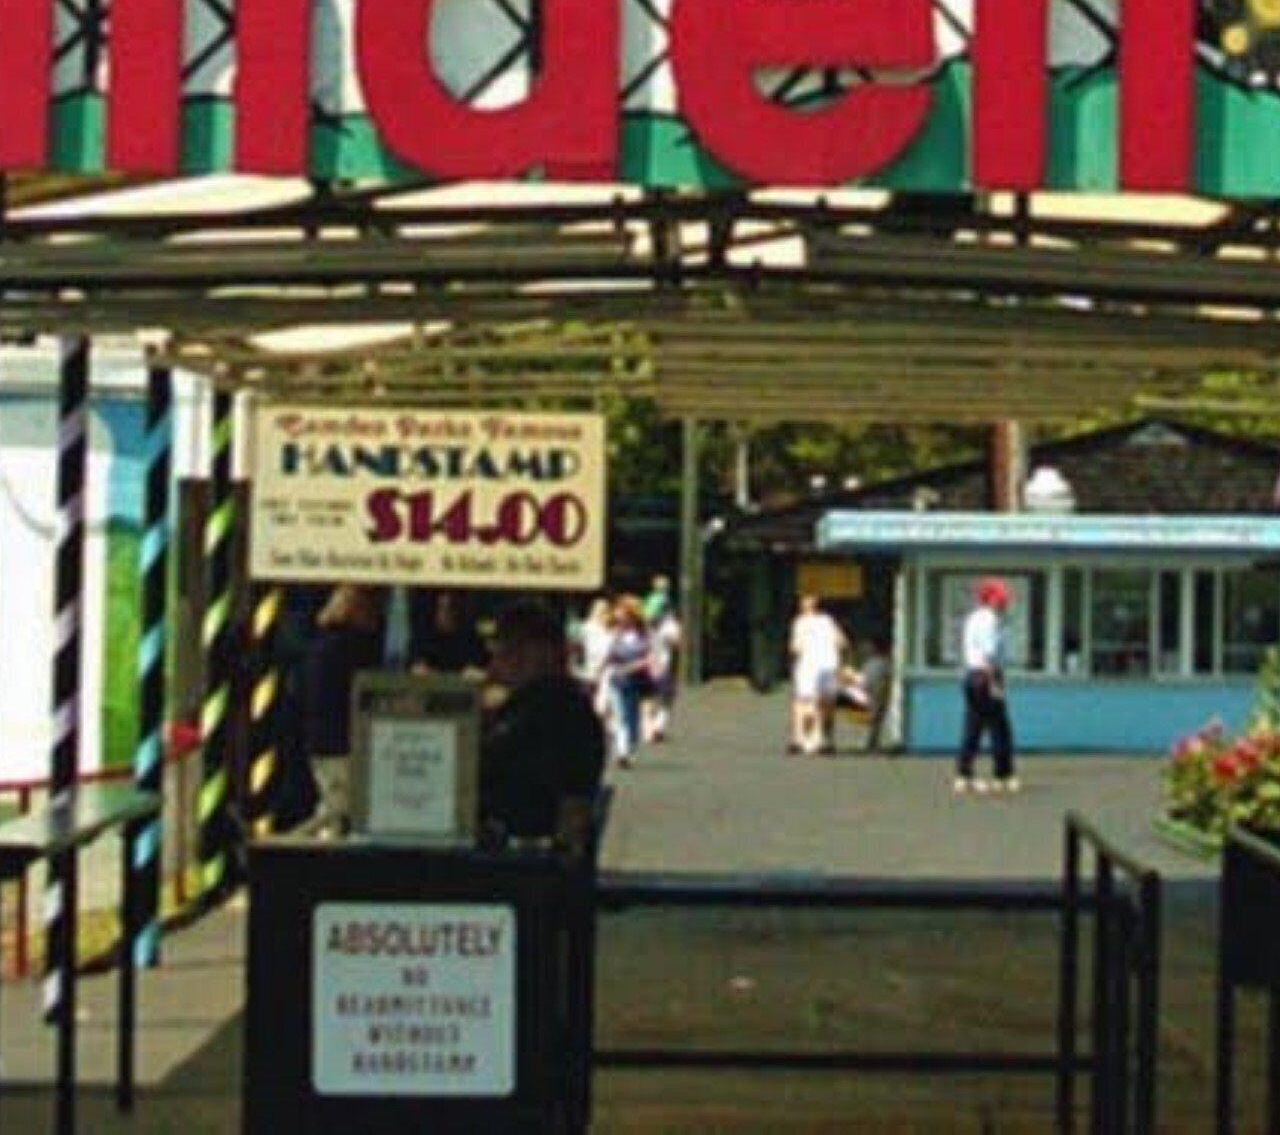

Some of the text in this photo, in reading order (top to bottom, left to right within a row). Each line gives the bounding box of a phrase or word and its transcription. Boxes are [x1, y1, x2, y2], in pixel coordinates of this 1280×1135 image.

[274, 413, 386, 439] Camden
[280, 442, 581, 482] HANDSTAMP
[366, 487, 588, 549] $14.00
[326, 921, 502, 957] ABSOLUTELY
[401, 967, 429, 985] NO
[369, 1025, 460, 1044] WITHOUT
[352, 1052, 477, 1075] HANDSTAMP
